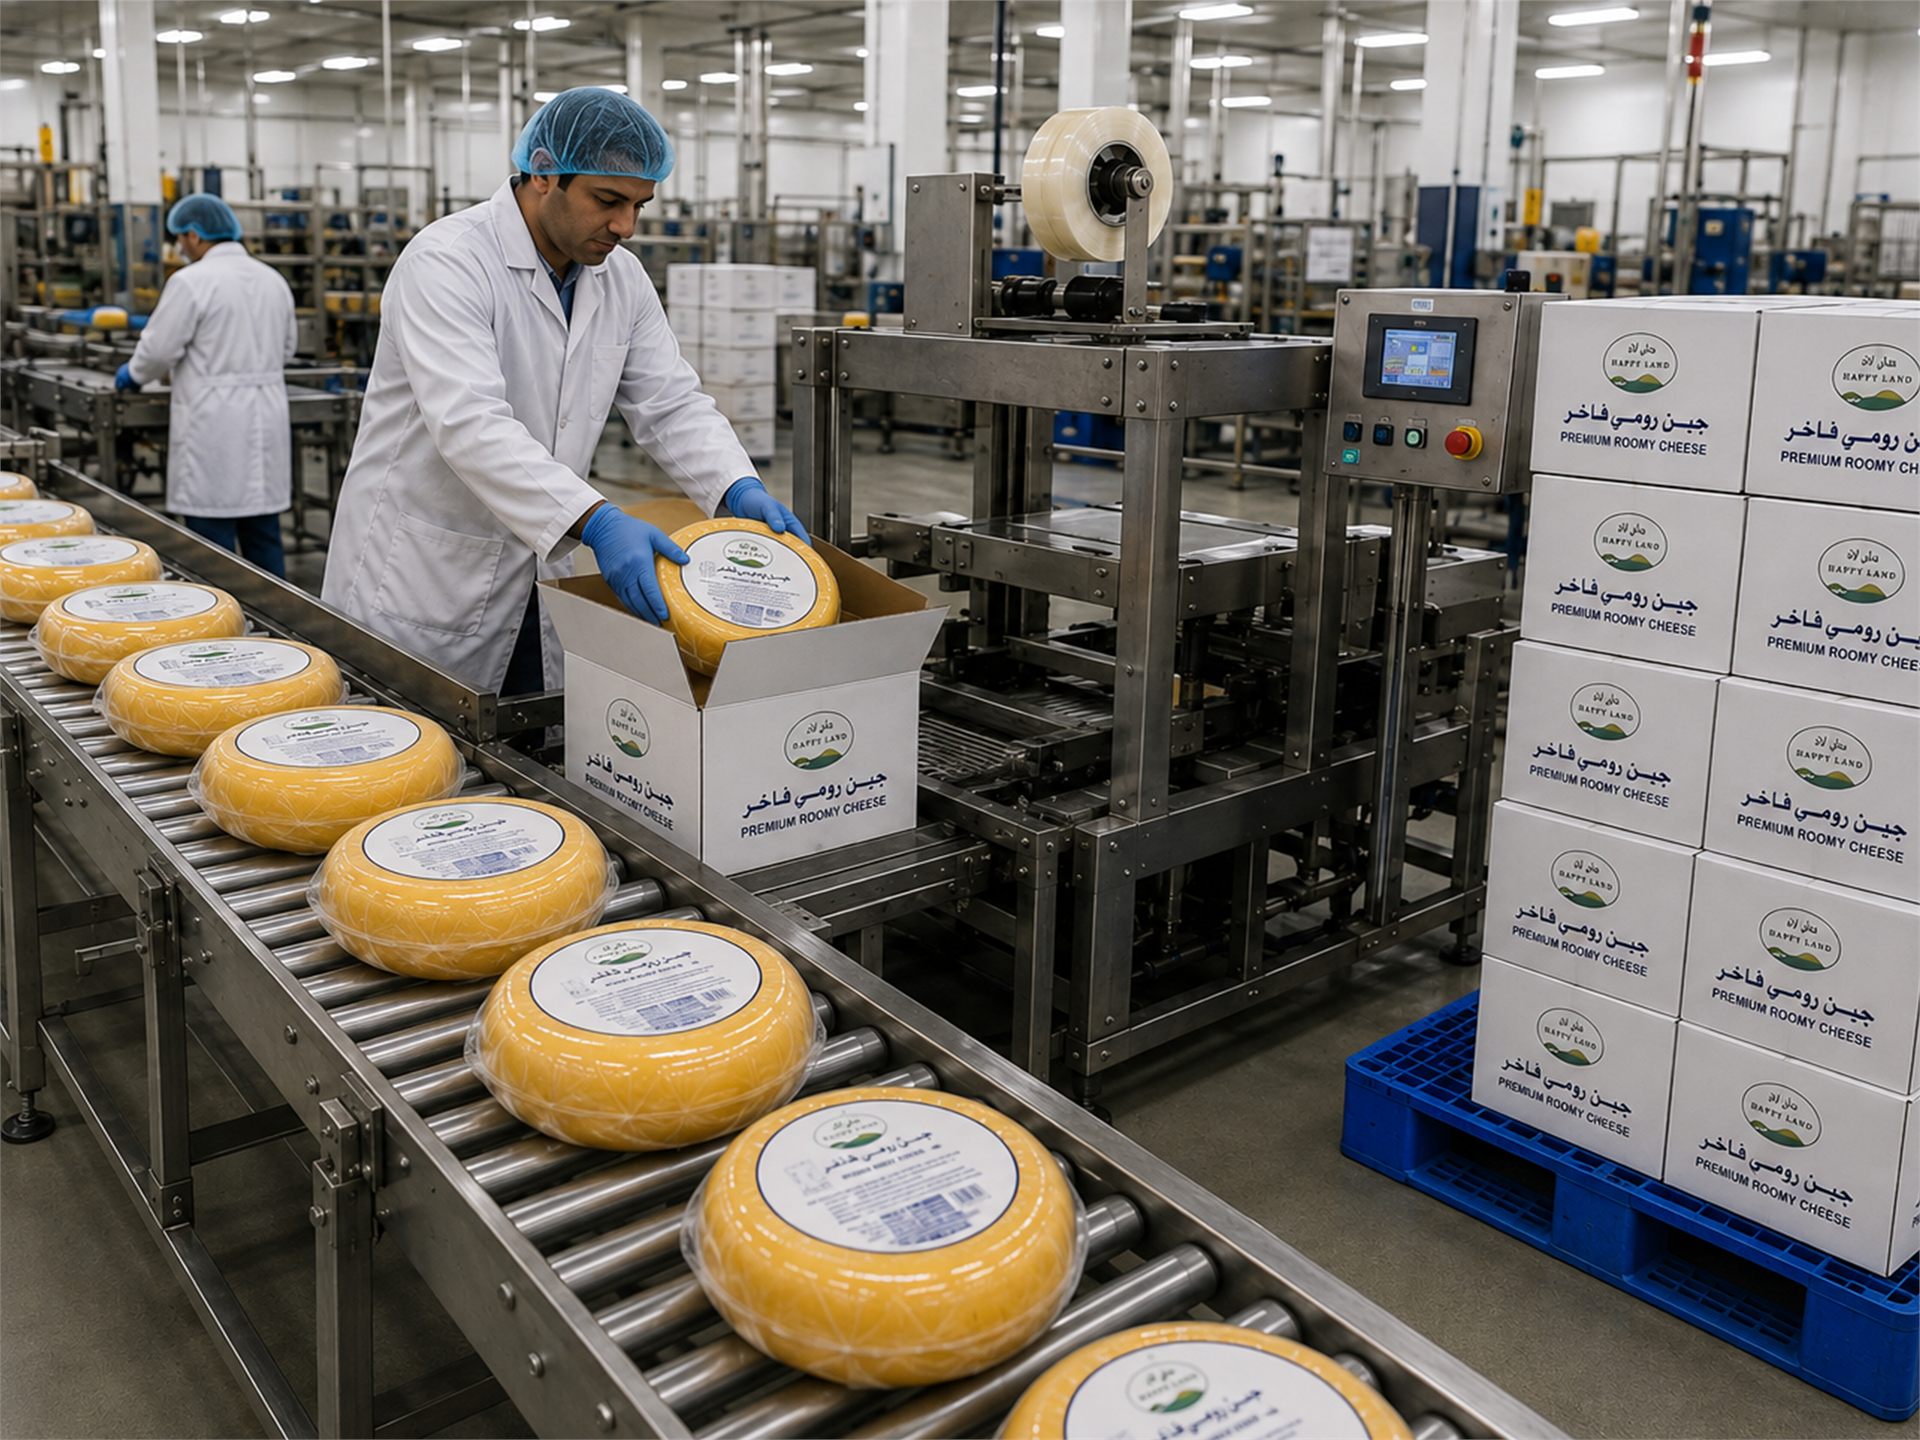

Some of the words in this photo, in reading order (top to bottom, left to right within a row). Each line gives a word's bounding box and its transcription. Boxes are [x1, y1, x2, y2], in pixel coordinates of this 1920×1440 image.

[1882, 375, 1912, 383] LAND
[1560, 431, 1611, 446] PREMIUM
[1614, 436, 1655, 450] ROOMY
[1659, 440, 1707, 455] CHEESE
[1781, 451, 1841, 467] PREMIUM
[1845, 457, 1895, 472] ROOMY
[1866, 568, 1896, 579] LAND
[1551, 603, 1600, 620] PREMIUM
[1604, 612, 1645, 627] ROOMY
[1649, 619, 1696, 636] CHEESE
[1767, 636, 1825, 655] PREMIUM
[1829, 646, 1877, 664] ROOMY
[1881, 655, 1920, 671] CHEE
[1834, 756, 1863, 769] LAND
[1529, 765, 1578, 785] PREMIUM
[1580, 777, 1620, 795] ROOMY
[1623, 787, 1670, 808] CHEESE
[741, 817, 796, 838] PREMIUM
[800, 807, 840, 824] ROOMY
[843, 796, 886, 814] CHEESE
[1737, 814, 1794, 836] PREMIUM
[1798, 829, 1845, 848] ROOMY
[1849, 841, 1904, 864] CHEESE
[1512, 926, 1559, 948] PREMIUM
[1562, 941, 1600, 961] ROOMY
[1603, 954, 1648, 977] CHEESE
[1712, 988, 1767, 1014] PREMIUM
[1770, 1006, 1816, 1029] ROOMY
[1819, 1022, 1872, 1048] CHEESE
[1498, 1077, 1544, 1102] PREMIUM
[1546, 1096, 1584, 1118] ROOMY
[1586, 1112, 1630, 1137] CHEESE
[1696, 1156, 1749, 1186] PREMIUM
[1752, 1180, 1796, 1206] ROOMY
[1800, 1200, 1851, 1228] CHEESE
